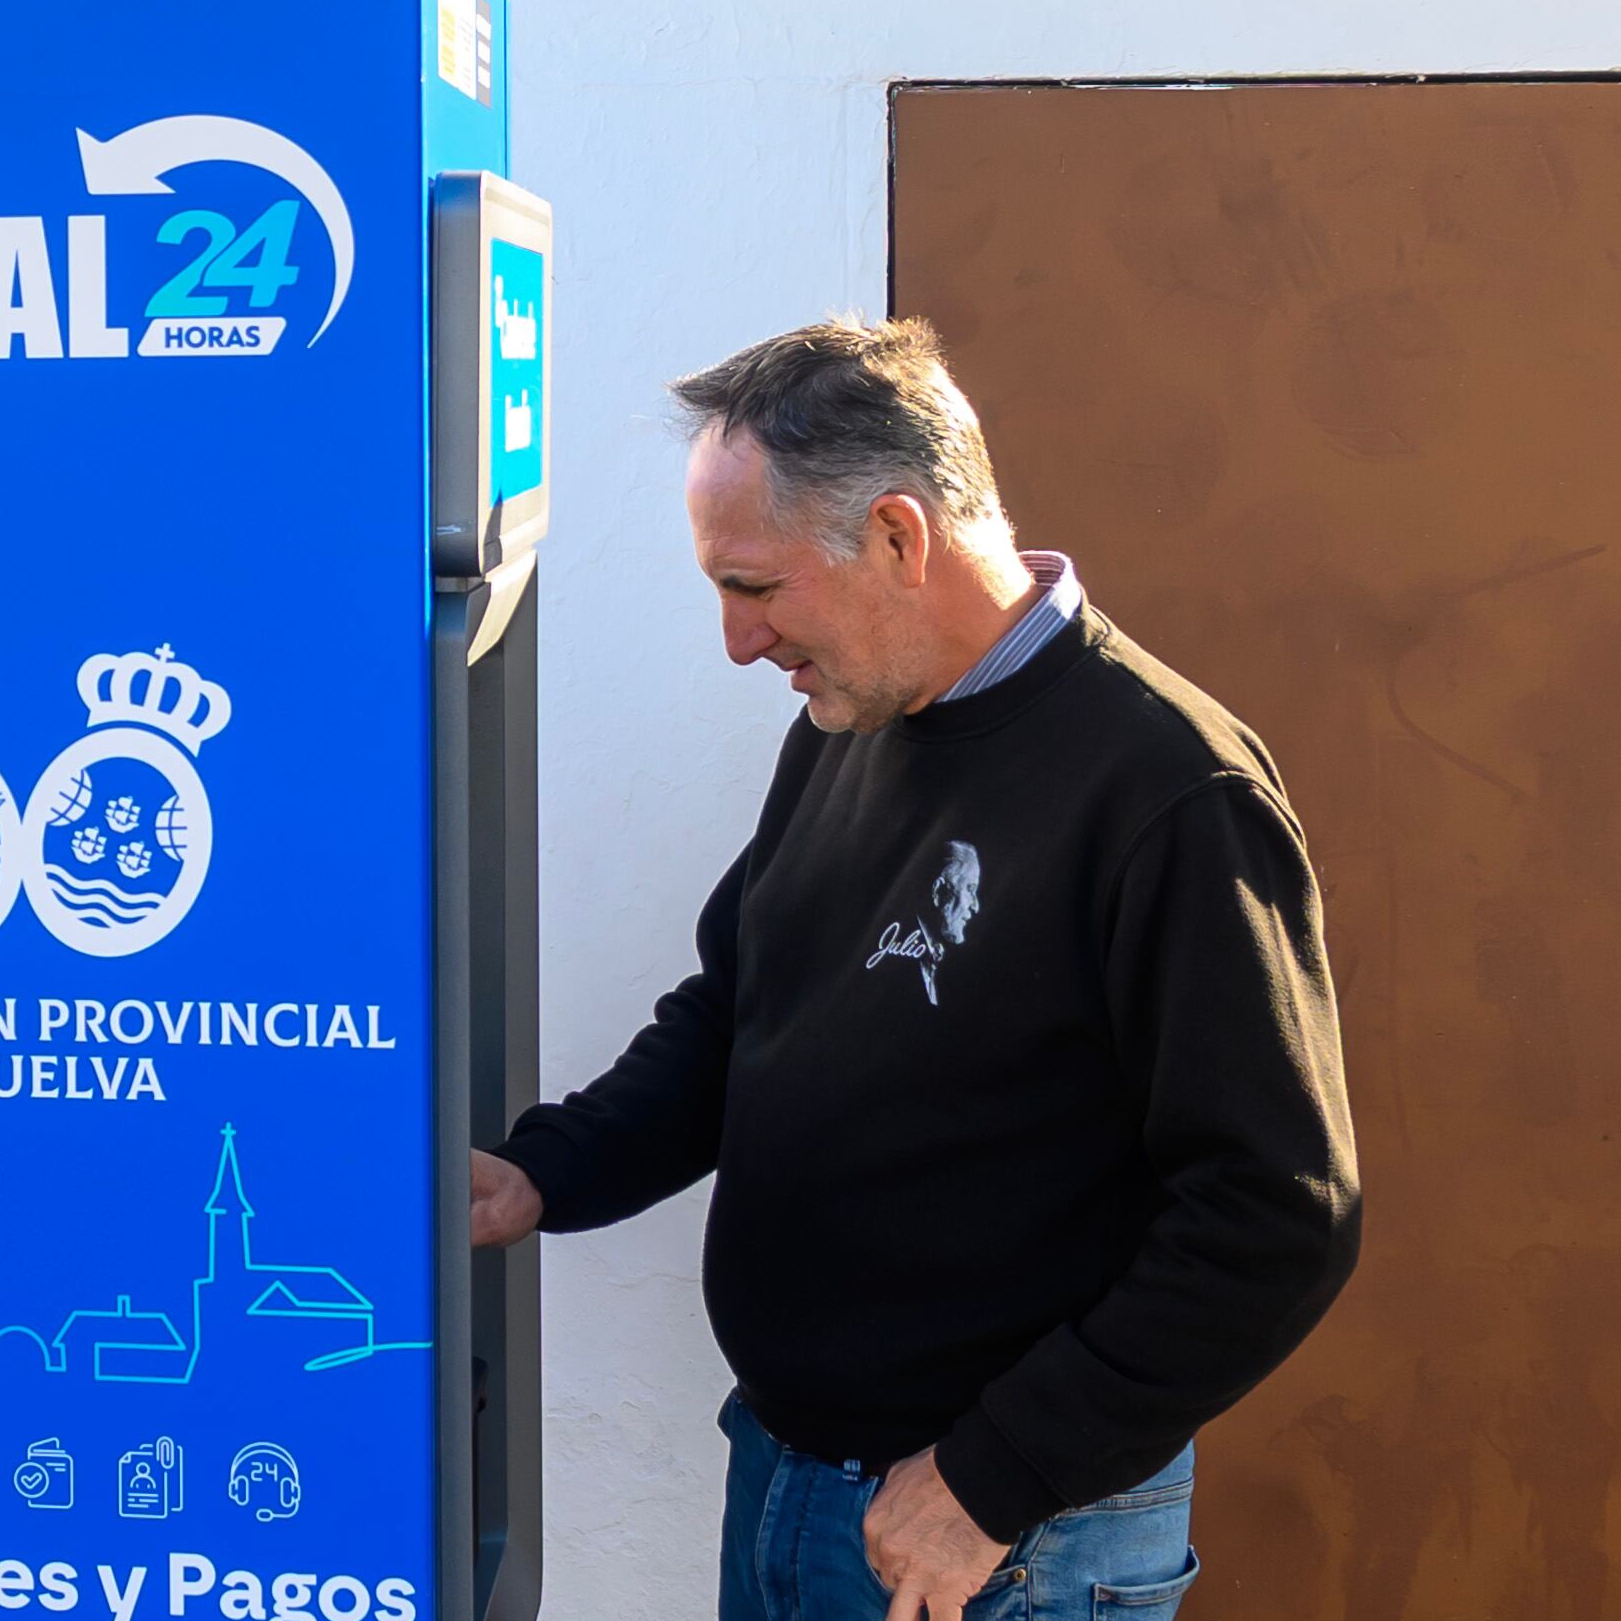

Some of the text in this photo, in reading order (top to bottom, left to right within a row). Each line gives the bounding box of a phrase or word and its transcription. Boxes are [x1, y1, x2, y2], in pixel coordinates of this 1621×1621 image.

[143, 199, 301, 318] 24
[164, 325, 261, 349] HORAS
[865, 921, 926, 969] Julio
[39, 999, 396, 1049] PROVINCIAL
[250, 1461, 278, 1482] 24
